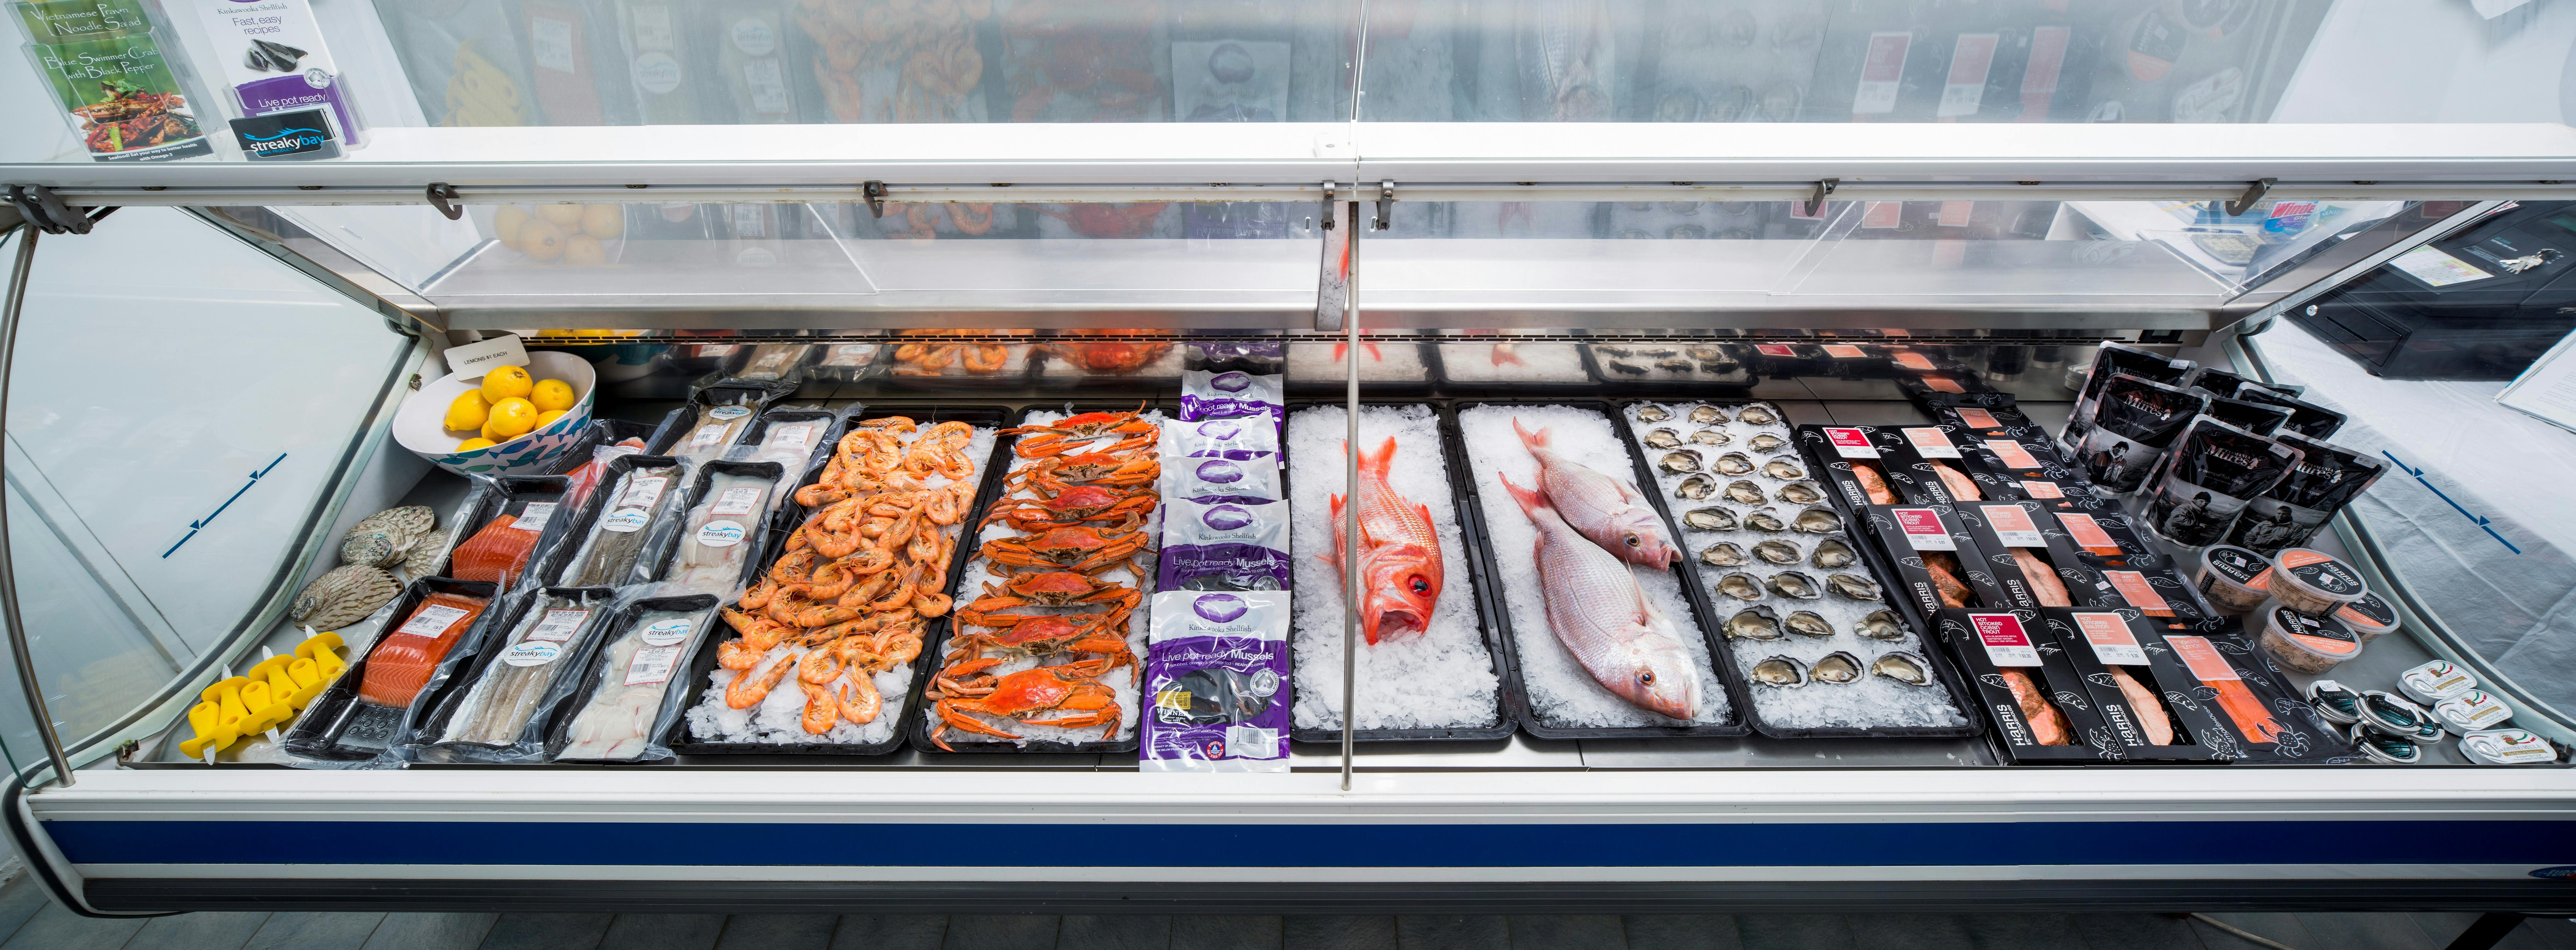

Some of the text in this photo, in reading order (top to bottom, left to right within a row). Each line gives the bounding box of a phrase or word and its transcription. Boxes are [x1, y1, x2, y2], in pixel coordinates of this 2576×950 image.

[31, 4, 128, 21] Vietnamese Prawn
[217, 3, 288, 14] Kinkawooka Shellfish
[232, 16, 282, 26] Fast, easy
[54, 21, 103, 35] Noodle
[244, 25, 280, 35] recipes
[43, 47, 158, 69] Blue Swimmer Crab
[68, 71, 86, 80] with
[84, 65, 122, 78] Black
[258, 93, 326, 108] Live pot ready
[250, 135, 324, 152] streakybay
[2270, 202, 2317, 219] Winde
[464, 356, 486, 365] LEMONS
[1217, 402, 1271, 411] ready Mussels
[2124, 395, 2163, 417] Mures
[2140, 399, 2164, 411] TASMANIA
[2117, 416, 2130, 424] smoky
[2138, 424, 2157, 434] chowder
[2205, 444, 2249, 467] Mures
[2225, 449, 2251, 460] TASMANIA
[2198, 467, 2222, 478] provençal
[2307, 463, 2334, 472] TASMANIA
[2303, 486, 2320, 497] bisque
[702, 531, 741, 539] streakybay
[1174, 556, 1191, 565] Live
[1236, 558, 1275, 567] Mussels
[1162, 649, 1274, 661] Live pot ready Mussels
[2448, 671, 2461, 680] RECCA
[2481, 701, 2495, 710] RECCA
